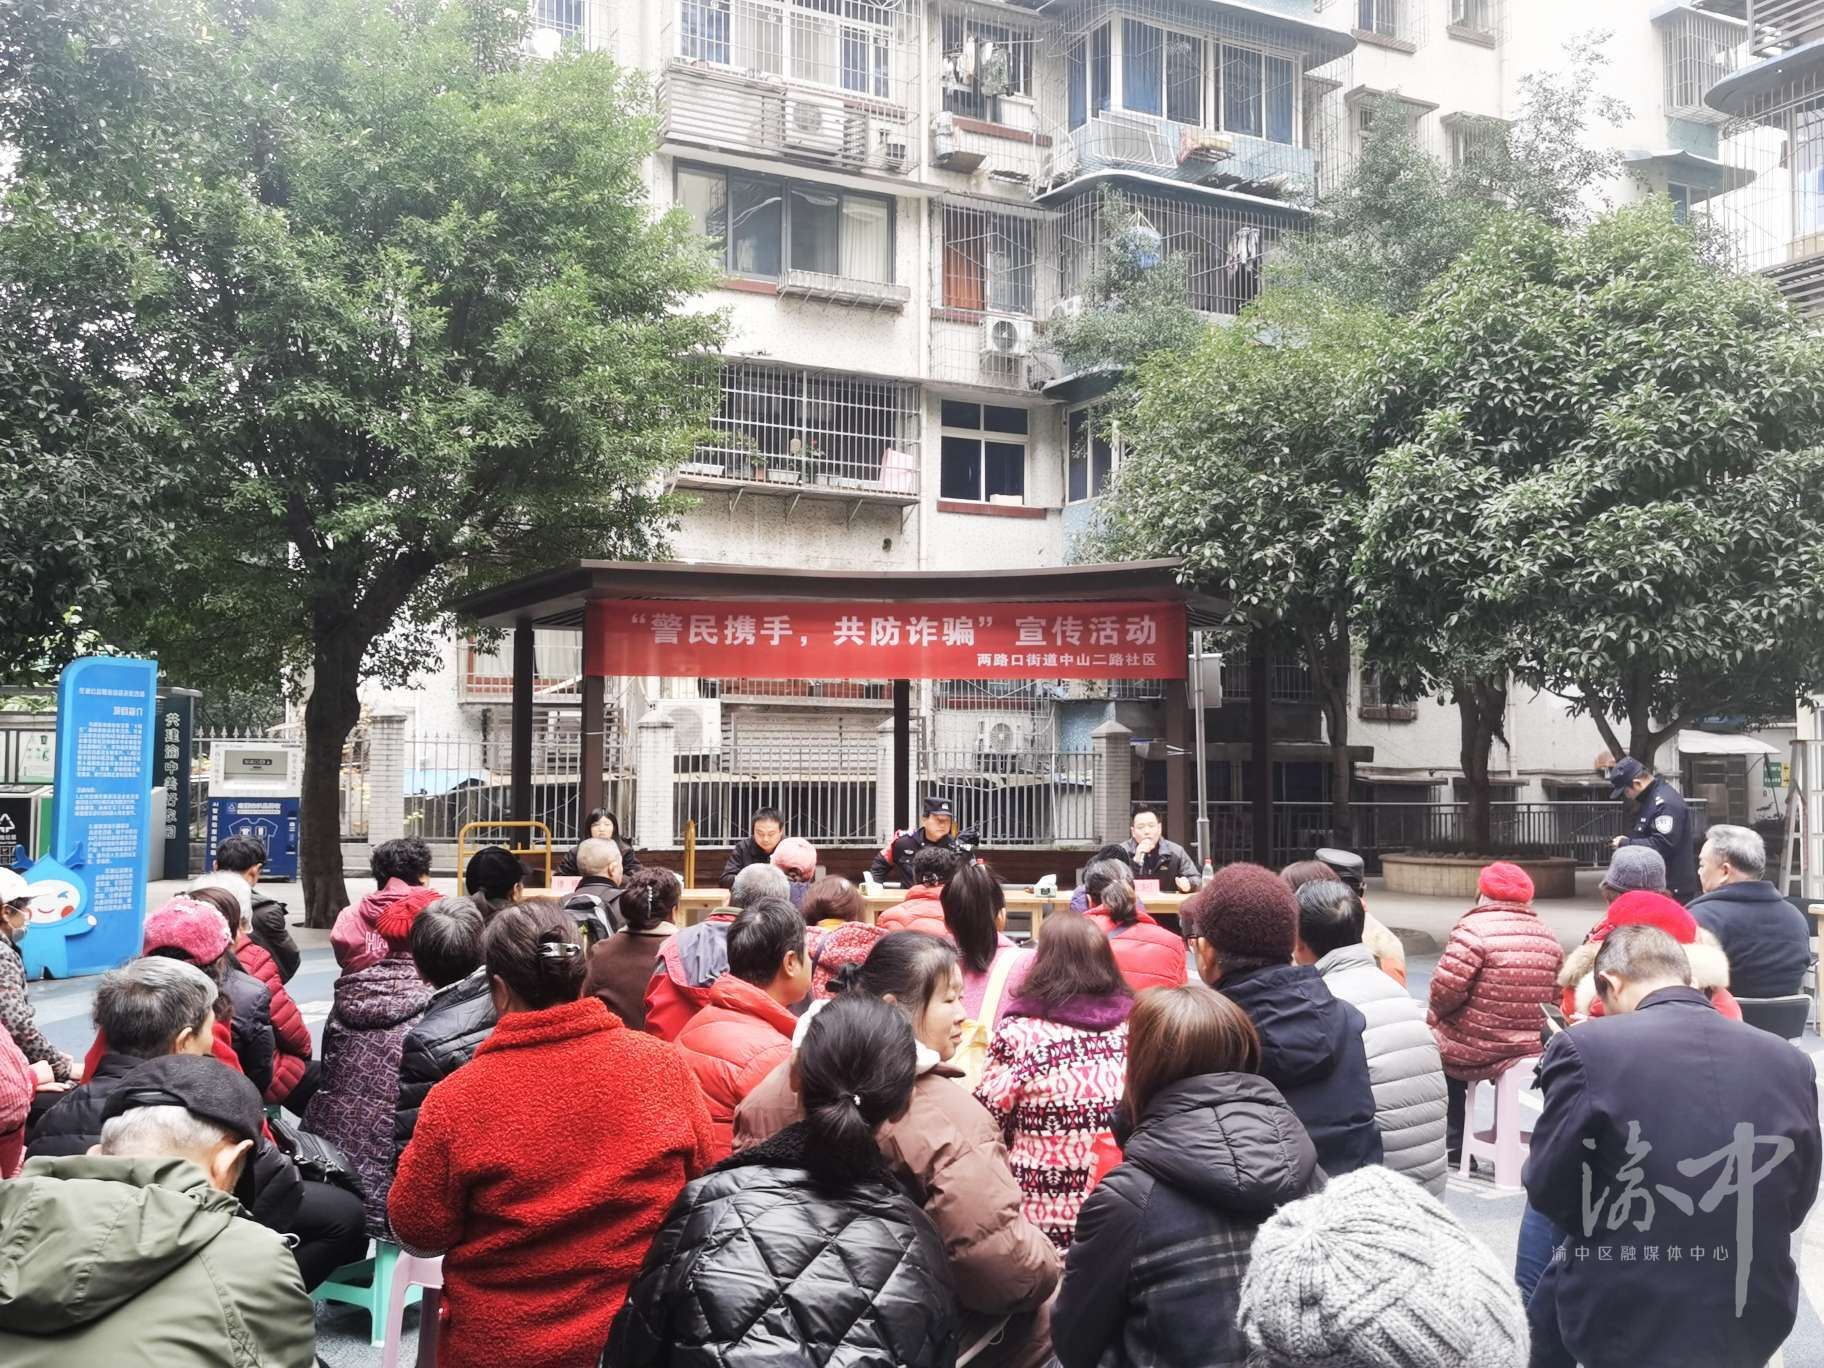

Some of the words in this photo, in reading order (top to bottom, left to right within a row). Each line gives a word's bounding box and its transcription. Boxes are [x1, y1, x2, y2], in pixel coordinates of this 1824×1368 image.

[976, 652, 1158, 667] 两路口街道中山二路社区
